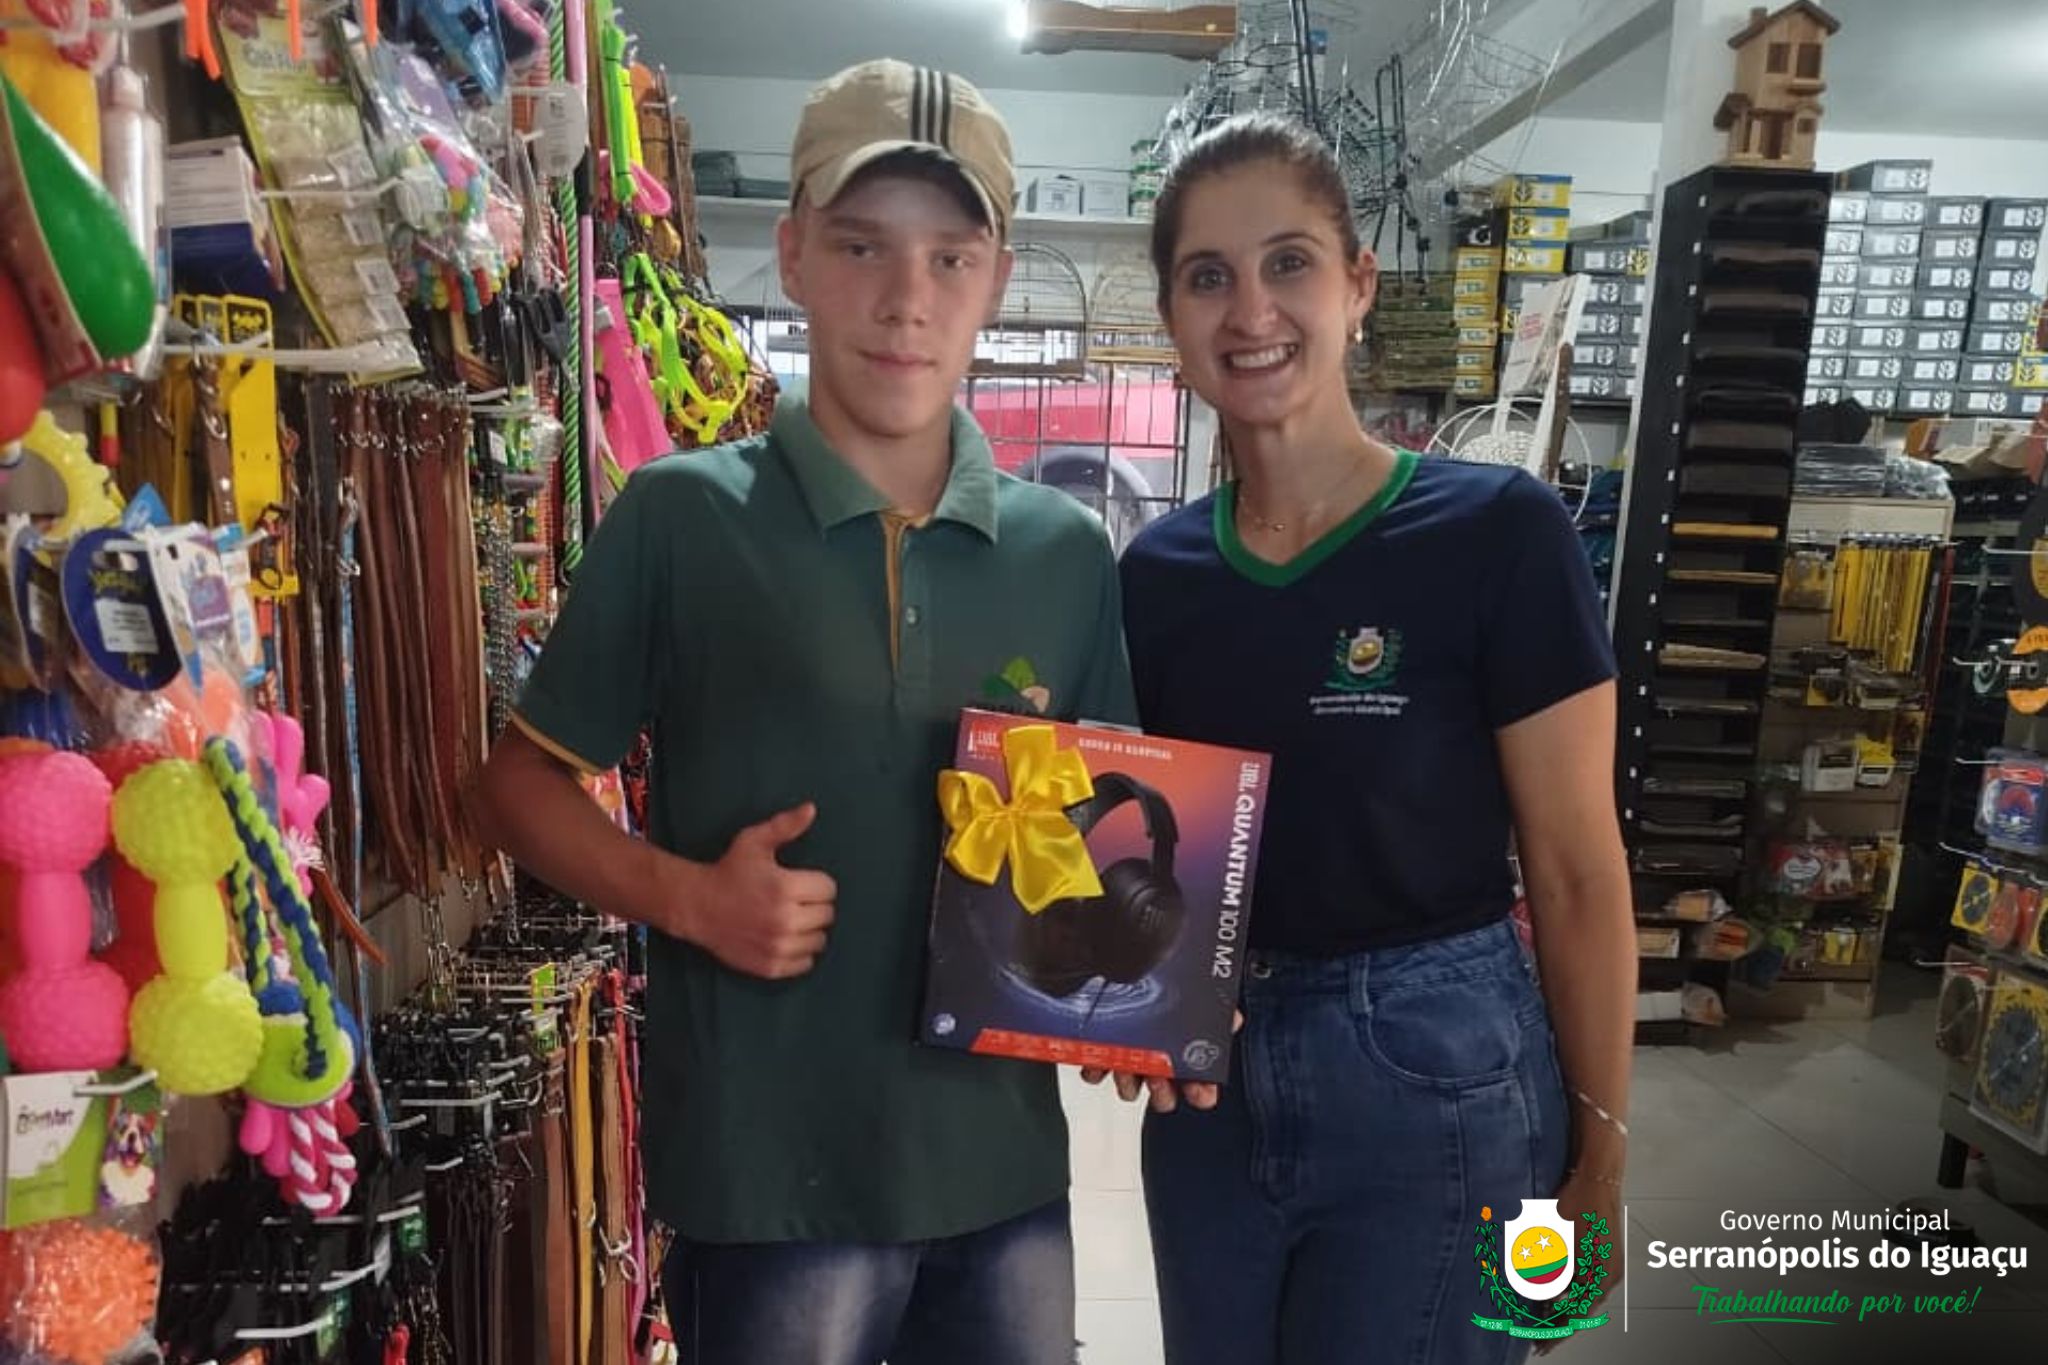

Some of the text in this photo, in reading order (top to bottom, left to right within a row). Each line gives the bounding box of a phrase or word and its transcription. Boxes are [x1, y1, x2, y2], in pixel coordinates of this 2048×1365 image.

[1222, 794, 1255, 906] QUANTUM
[1218, 910, 1239, 941] 100
[1212, 945, 1234, 979] M2
